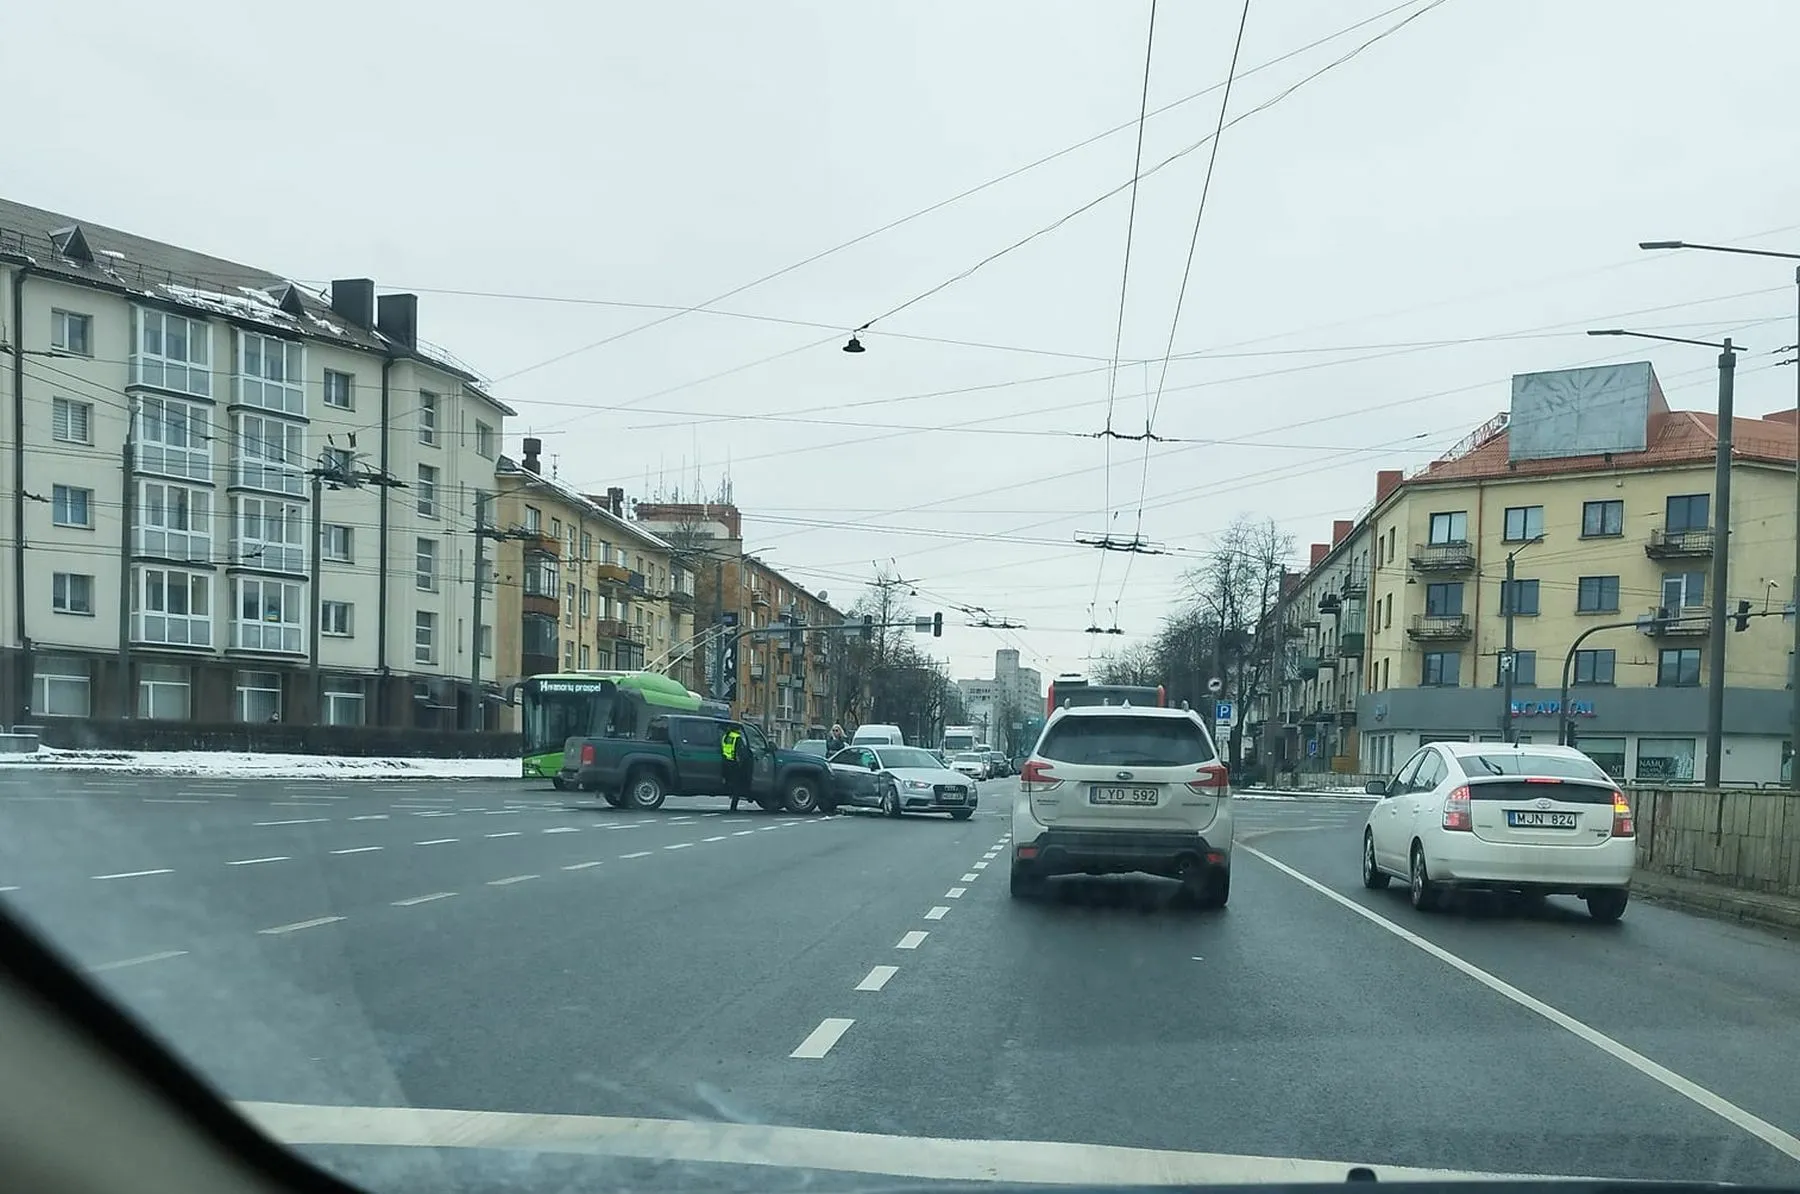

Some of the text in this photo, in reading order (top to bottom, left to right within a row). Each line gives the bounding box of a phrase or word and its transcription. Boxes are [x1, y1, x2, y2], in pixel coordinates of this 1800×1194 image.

[1220, 705, 1230, 717] P
[1098, 787, 1156, 801] LYD 592
[1516, 812, 1574, 826] MJN 824
